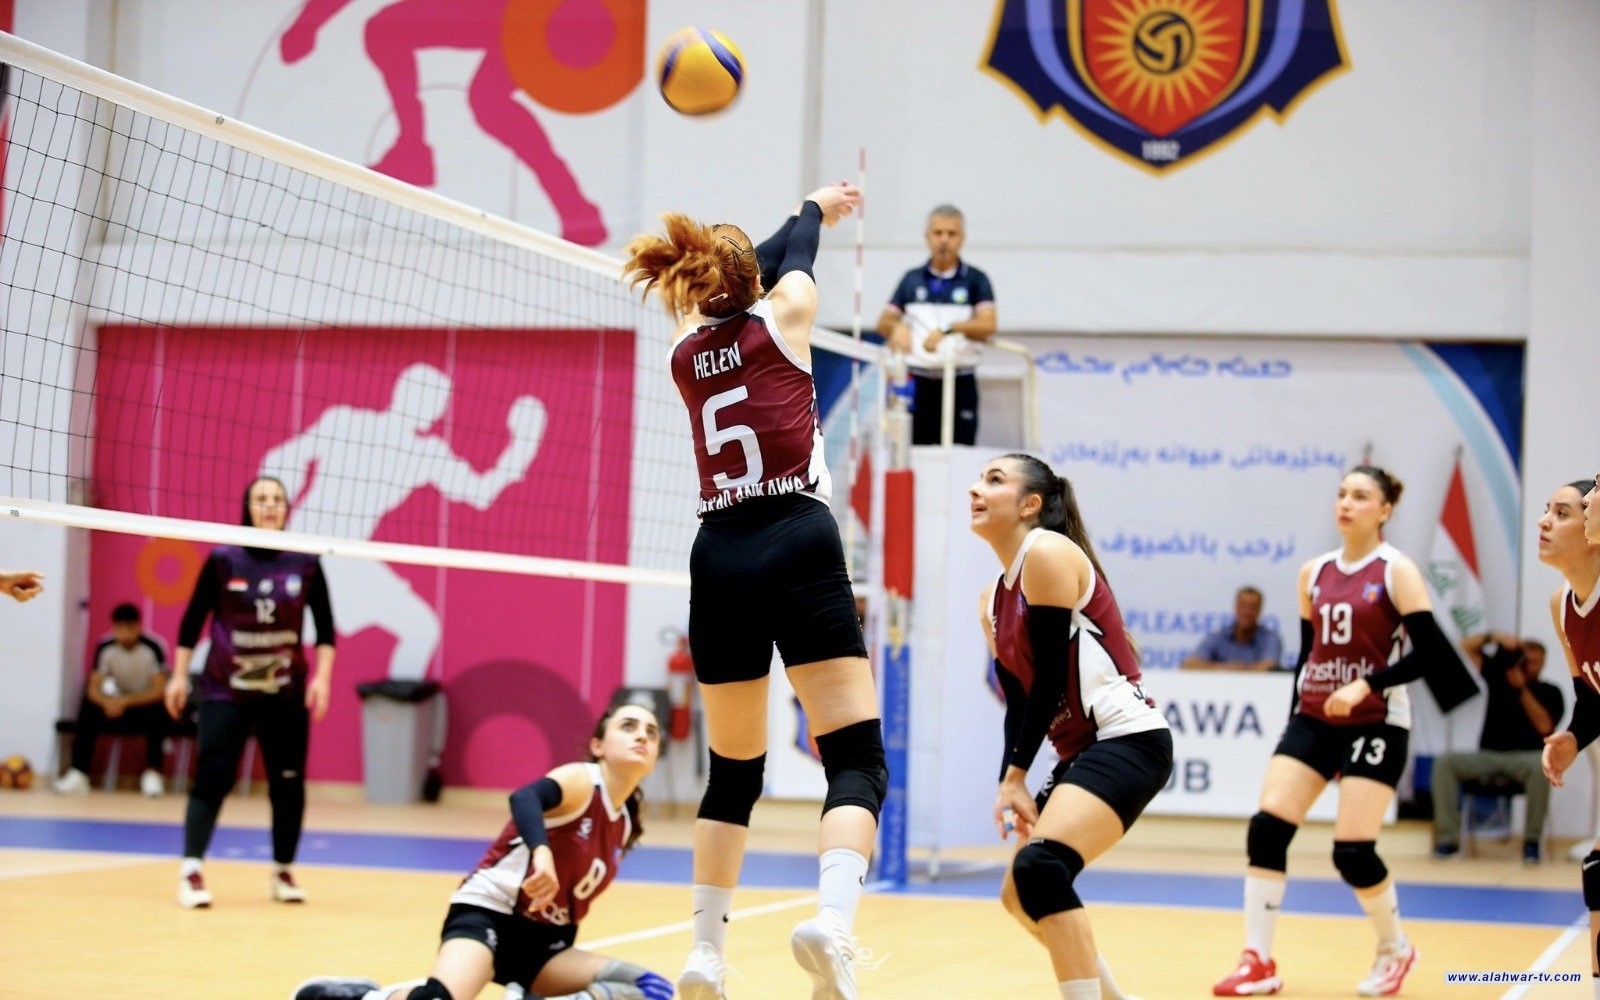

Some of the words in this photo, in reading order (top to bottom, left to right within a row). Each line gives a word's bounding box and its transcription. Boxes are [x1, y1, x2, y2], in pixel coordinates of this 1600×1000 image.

[693, 341, 743, 381] HELEN
[701, 385, 764, 489] 5
[254, 597, 277, 624] 12
[1318, 601, 1354, 646] 13
[1350, 735, 1387, 766] 13
[573, 857, 607, 901] 8
